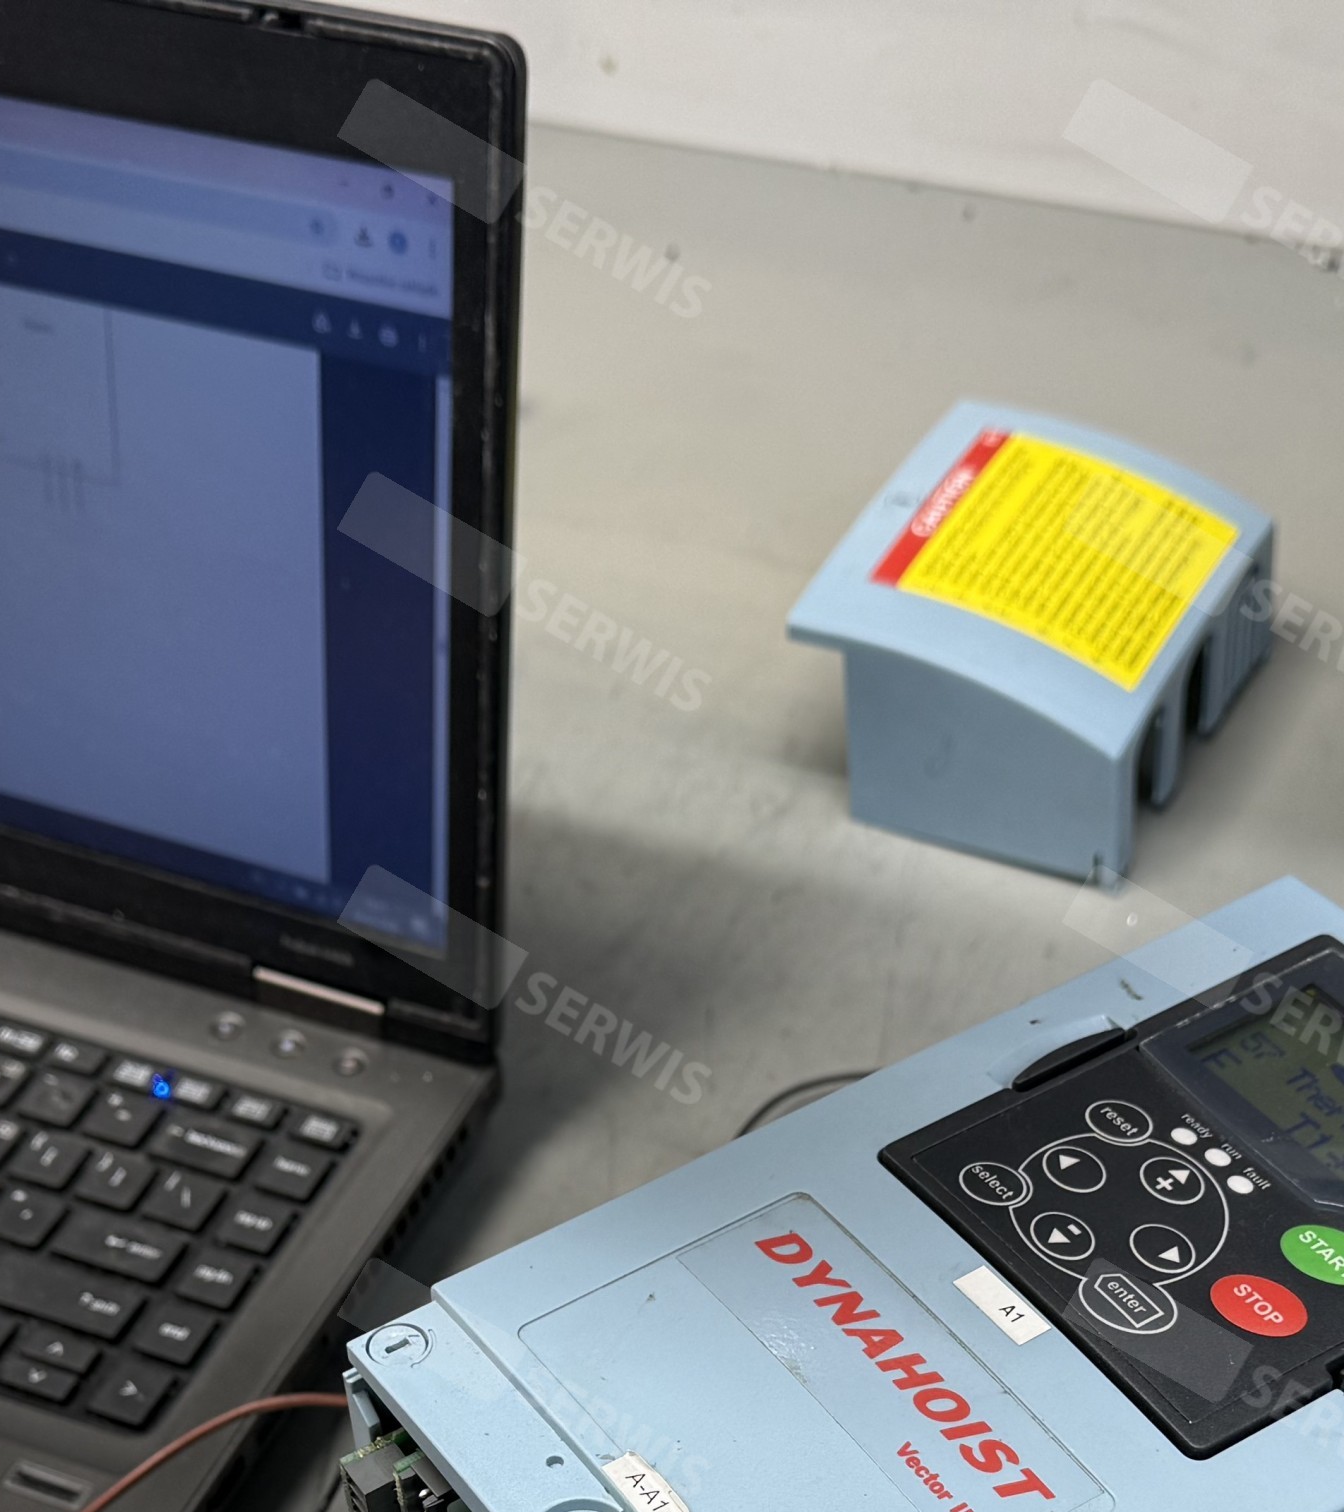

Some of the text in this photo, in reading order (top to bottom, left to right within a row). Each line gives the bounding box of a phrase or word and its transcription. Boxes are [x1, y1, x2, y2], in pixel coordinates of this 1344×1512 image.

[1099, 1105, 1139, 1137] reset
[1180, 1112, 1213, 1140] ready
[1221, 1141, 1243, 1161] run
[971, 1164, 1014, 1201] select
[1242, 1165, 1272, 1191] fault
[998, 1304, 1025, 1324] A1
[1107, 1278, 1147, 1316] enter
[1232, 1283, 1284, 1325] STOP
[754, 1232, 1056, 1500] DYNAHOIST
[896, 1440, 954, 1501] Vector
[625, 1473, 670, 1512] A-A1
